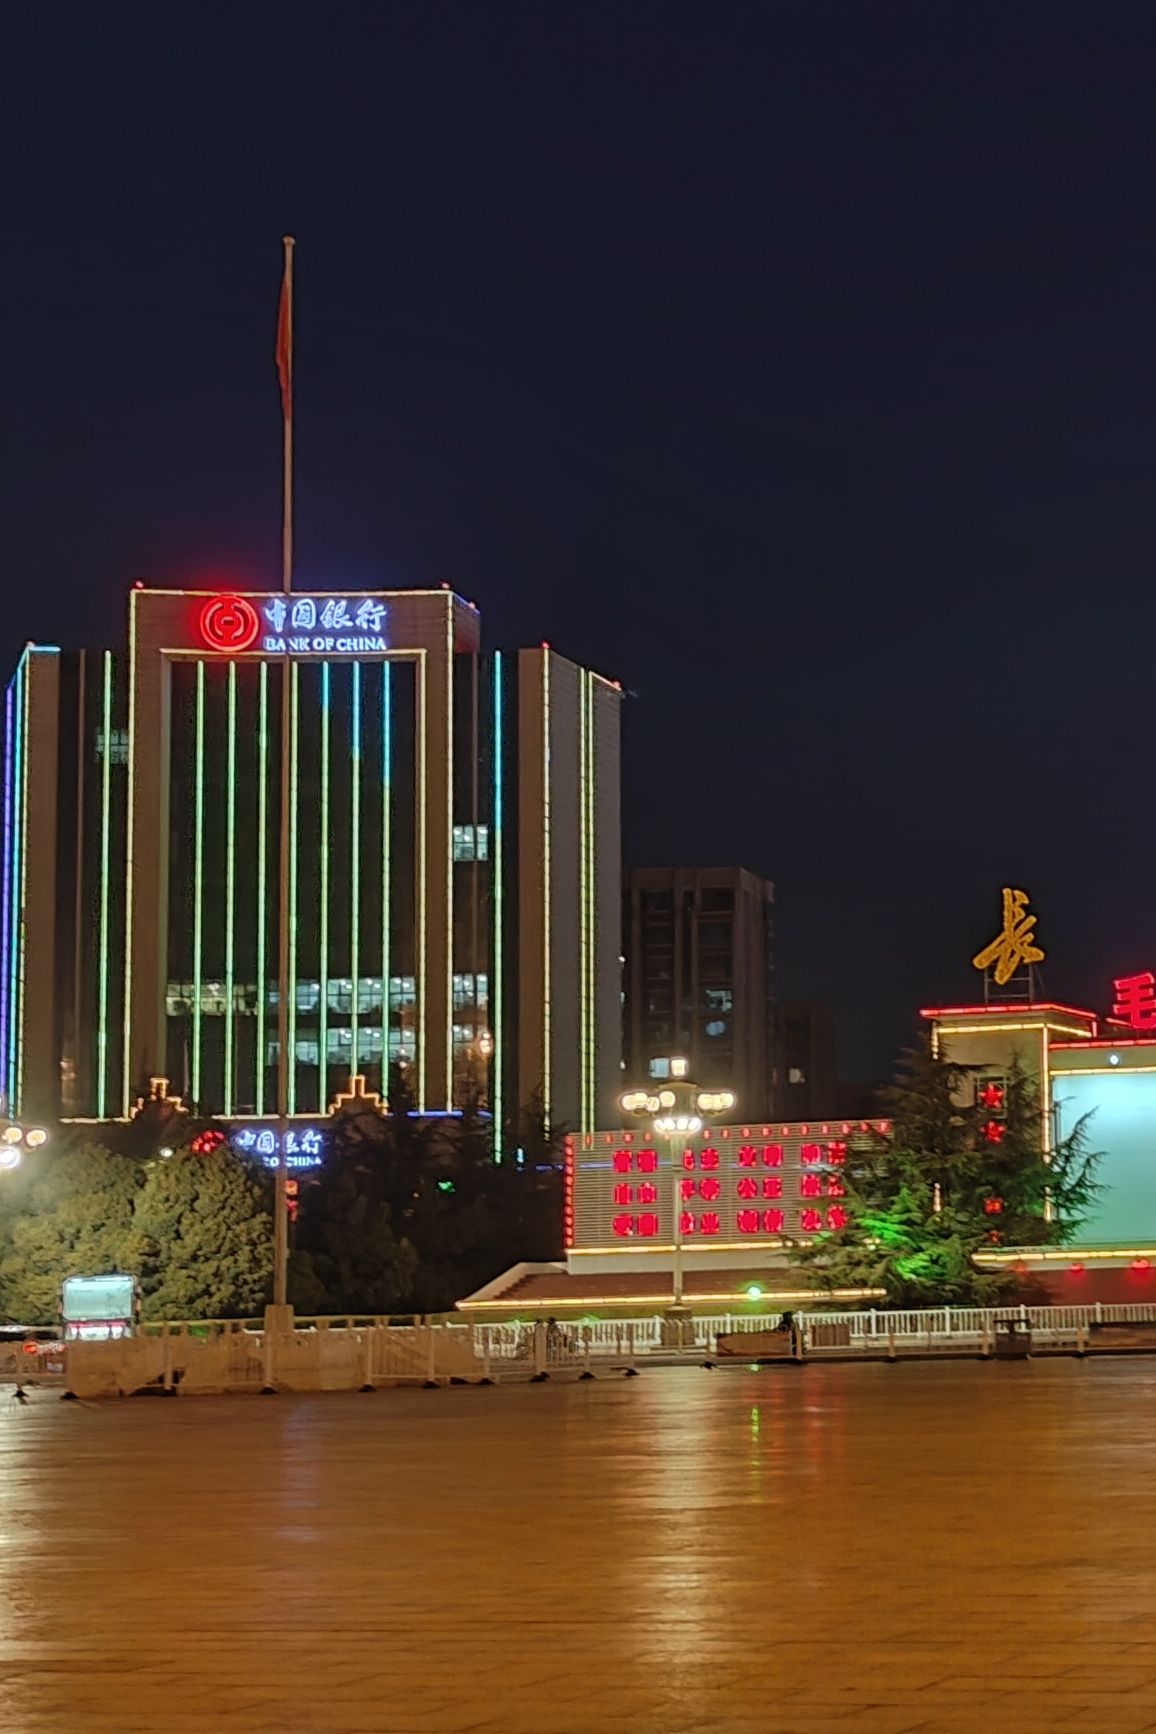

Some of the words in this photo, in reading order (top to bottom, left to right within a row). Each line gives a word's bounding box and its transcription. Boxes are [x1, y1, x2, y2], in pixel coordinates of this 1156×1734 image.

[264, 598, 388, 633] 中国银行
[264, 636, 310, 653] BANK
[312, 636, 335, 653] OF
[336, 636, 387, 653] CHINA
[973, 888, 1044, 984] 长
